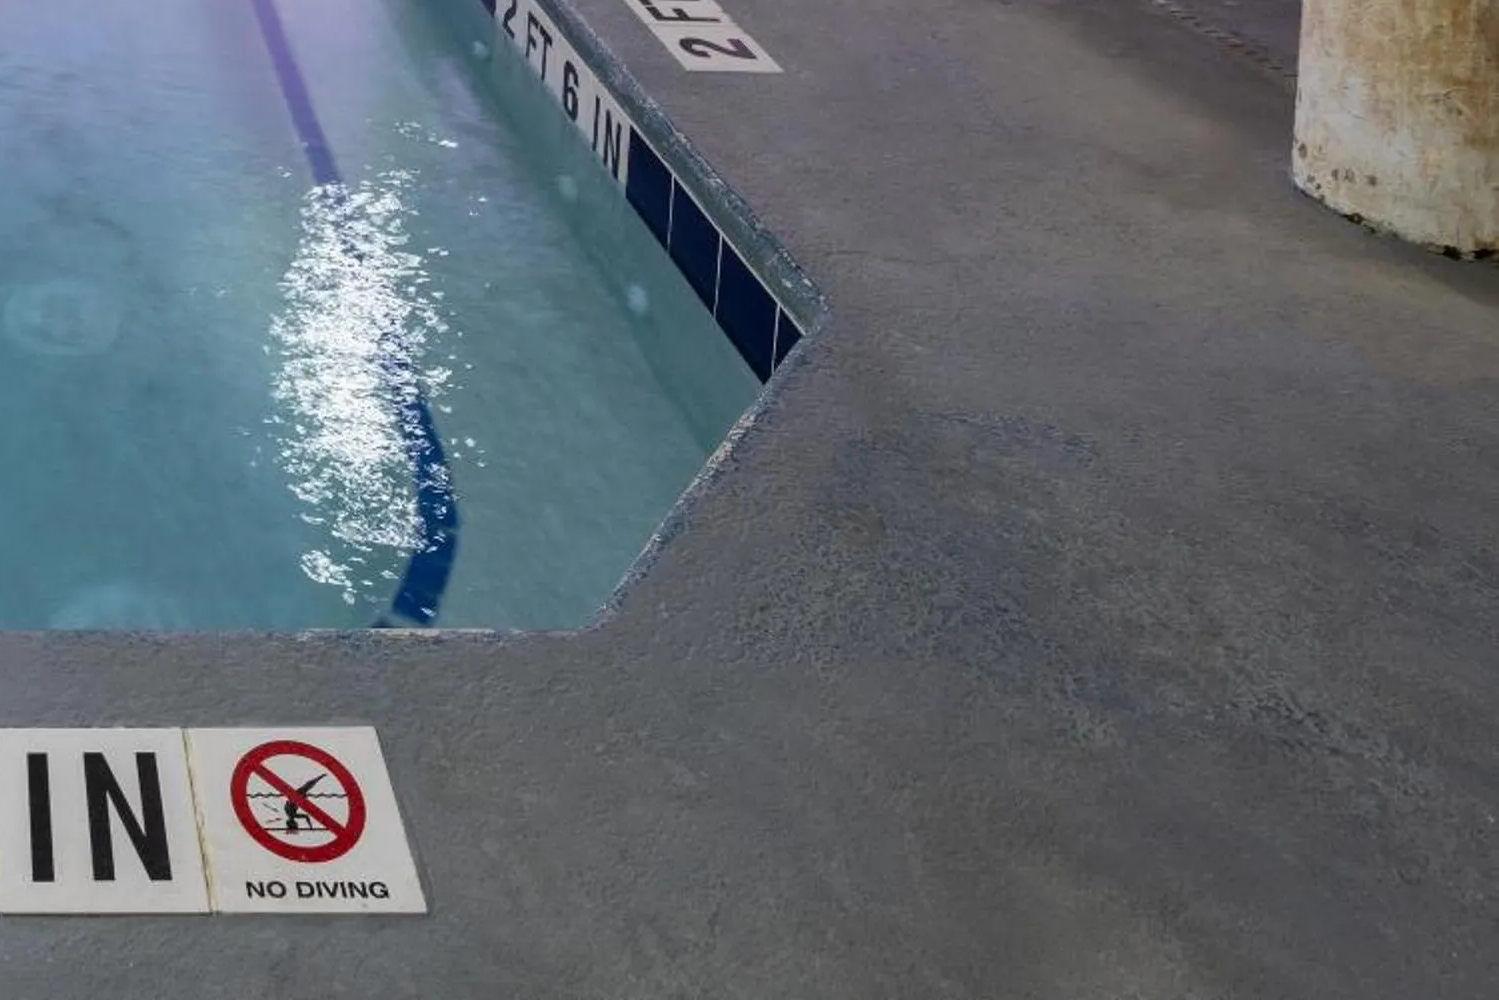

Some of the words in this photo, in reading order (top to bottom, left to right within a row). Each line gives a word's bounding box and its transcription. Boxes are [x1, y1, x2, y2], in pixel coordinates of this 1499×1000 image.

[679, 37, 759, 61] 2
[525, 11, 554, 82] FT
[561, 60, 579, 122] 6
[591, 97, 623, 181] IN
[26, 751, 174, 883] IN
[245, 880, 287, 899] NO
[295, 880, 390, 899] DIVING
